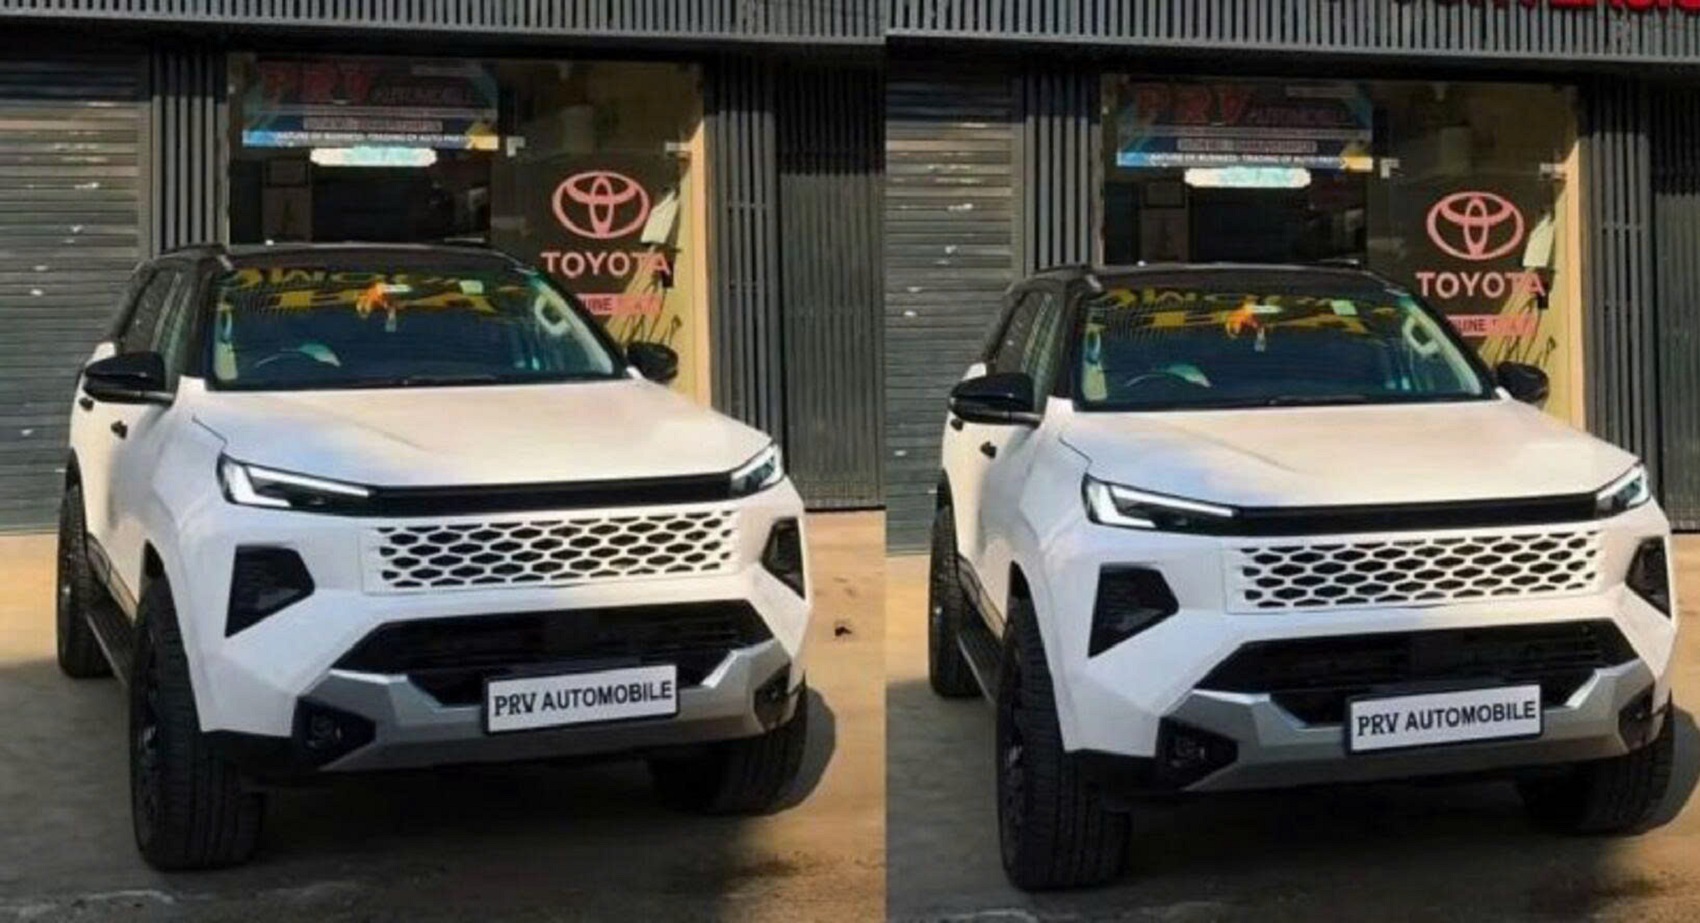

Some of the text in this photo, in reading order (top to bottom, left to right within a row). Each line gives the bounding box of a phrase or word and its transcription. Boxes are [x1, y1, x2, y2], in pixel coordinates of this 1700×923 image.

[541, 251, 671, 277] TOYOTA
[1416, 271, 1546, 299] TOYOTA
[494, 681, 673, 717] PRV AUTOMOBILE
[1357, 701, 1536, 737] PRV AUTOMOBILE
